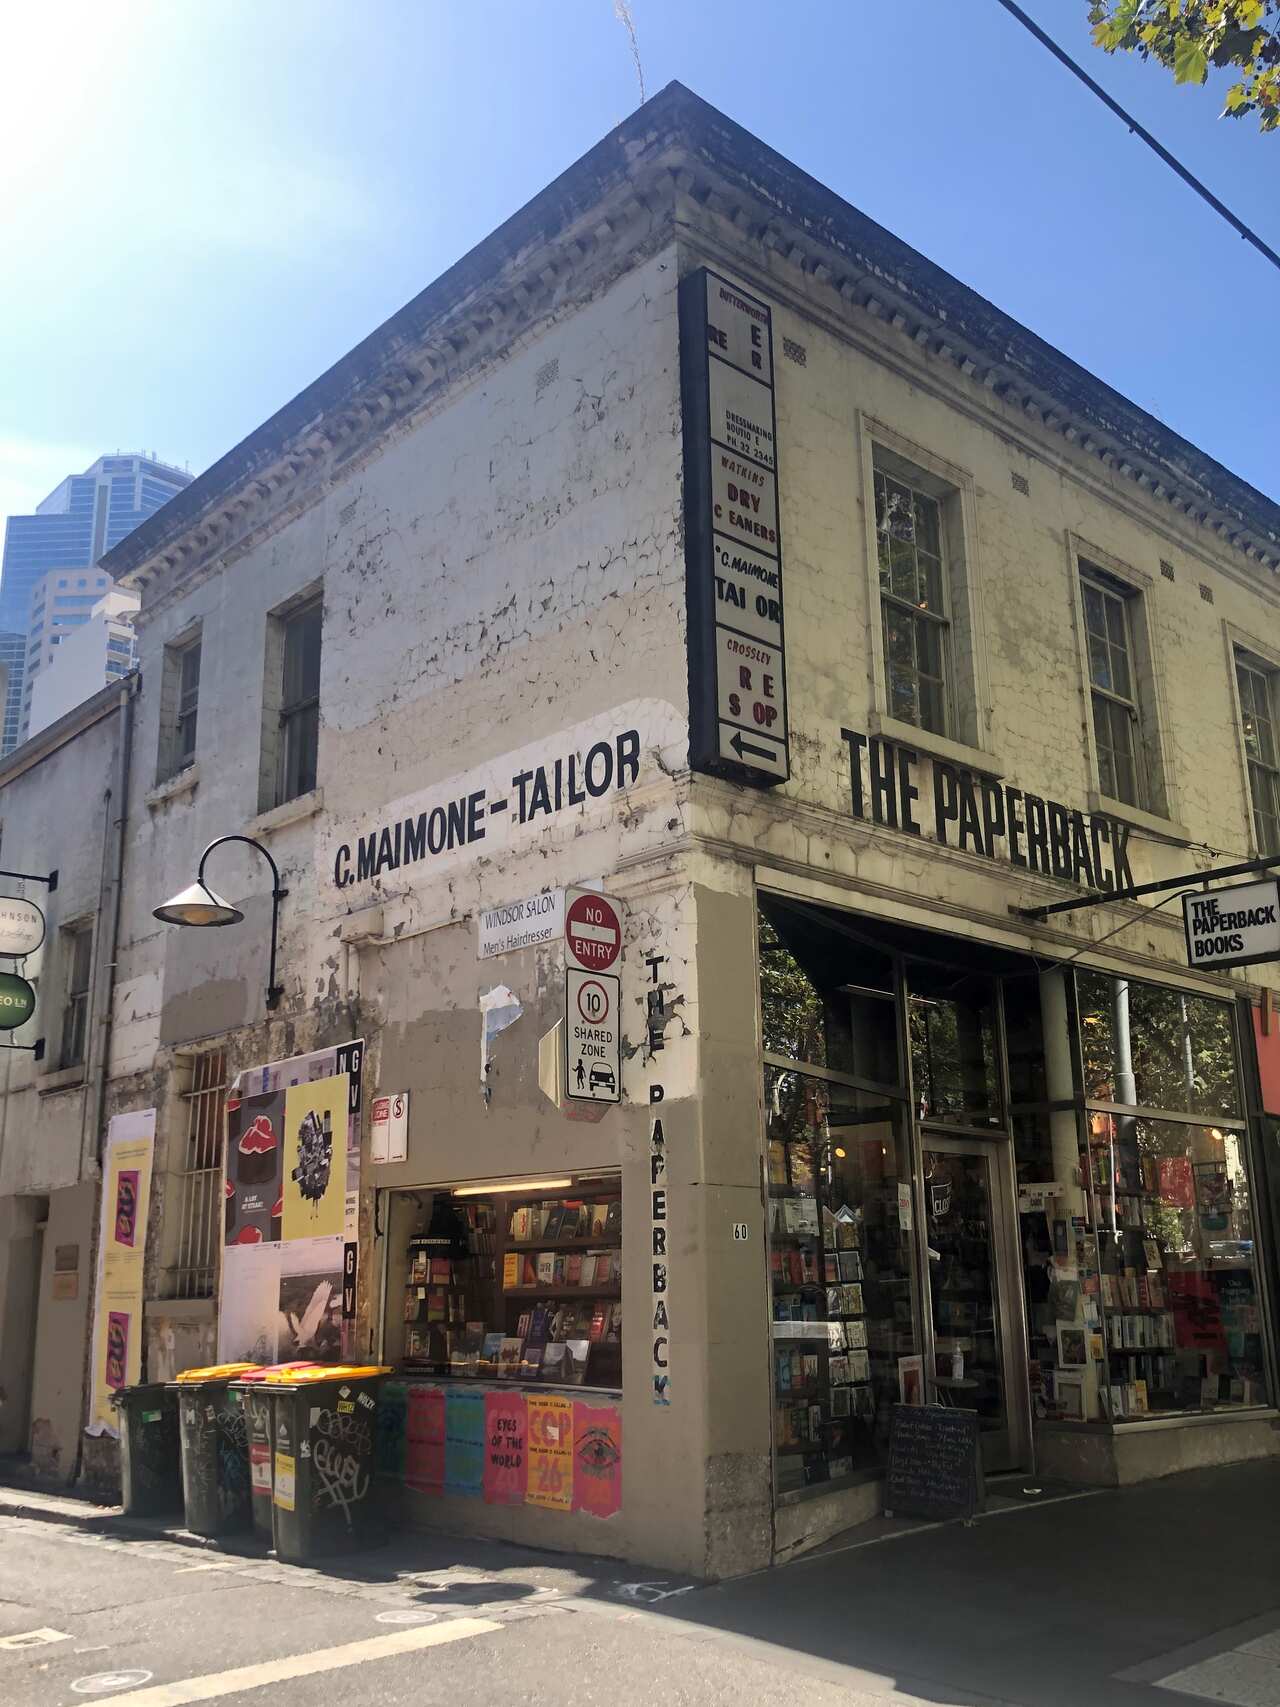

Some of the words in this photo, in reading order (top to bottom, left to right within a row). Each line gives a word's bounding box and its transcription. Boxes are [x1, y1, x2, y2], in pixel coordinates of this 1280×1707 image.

[726, 410, 773, 441] DRESSMAKING
[726, 421, 760, 446] BOUTIQE
[721, 456, 765, 487] WATKINS
[728, 482, 760, 513] DRY
[714, 504, 776, 543] CEANERS
[715, 576, 781, 624] TAIOR
[727, 638, 771, 666] CROSSLEY
[729, 693, 778, 728] SOP
[840, 727, 921, 835] THE
[931, 759, 1138, 901] PAPERBACK
[485, 903, 524, 930] WINDSOR
[526, 894, 556, 918] SALON
[585, 907, 603, 923] NO
[1191, 898, 1220, 918] THE
[1192, 904, 1277, 936] PAPERBACK
[506, 927, 553, 949] Hairdresser
[575, 940, 613, 960] ENTRY
[1194, 933, 1244, 958] BOOKS
[586, 993, 601, 1012] 10
[574, 1026, 613, 1043] SHARED
[581, 1043, 606, 1058] ZONE
[734, 1224, 747, 1240] 60
[497, 1419, 517, 1433] EYES
[491, 1436, 502, 1447] OF
[505, 1436, 523, 1450] THE
[491, 1454, 522, 1470] WORLD
